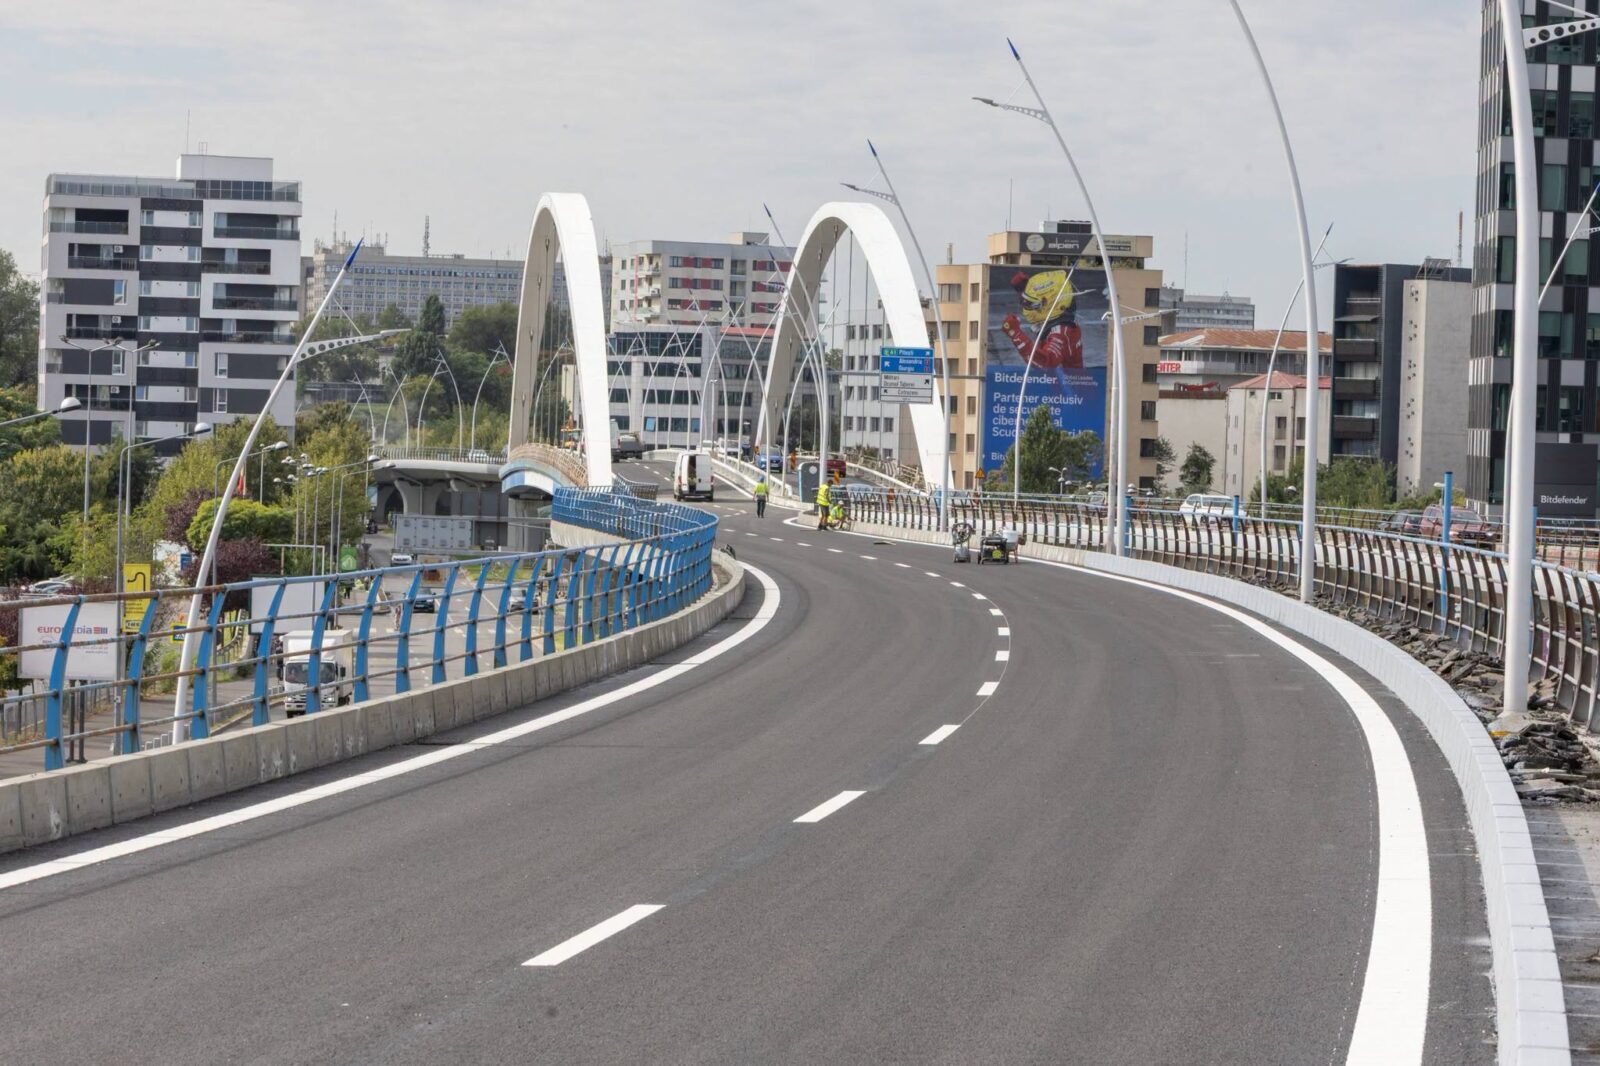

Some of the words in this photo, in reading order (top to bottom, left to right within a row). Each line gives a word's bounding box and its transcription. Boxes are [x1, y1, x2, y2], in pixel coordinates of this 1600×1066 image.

[1042, 394, 1083, 405] exclusiv
[993, 404, 1006, 414] de
[1541, 495, 1588, 504] Bitdefender
